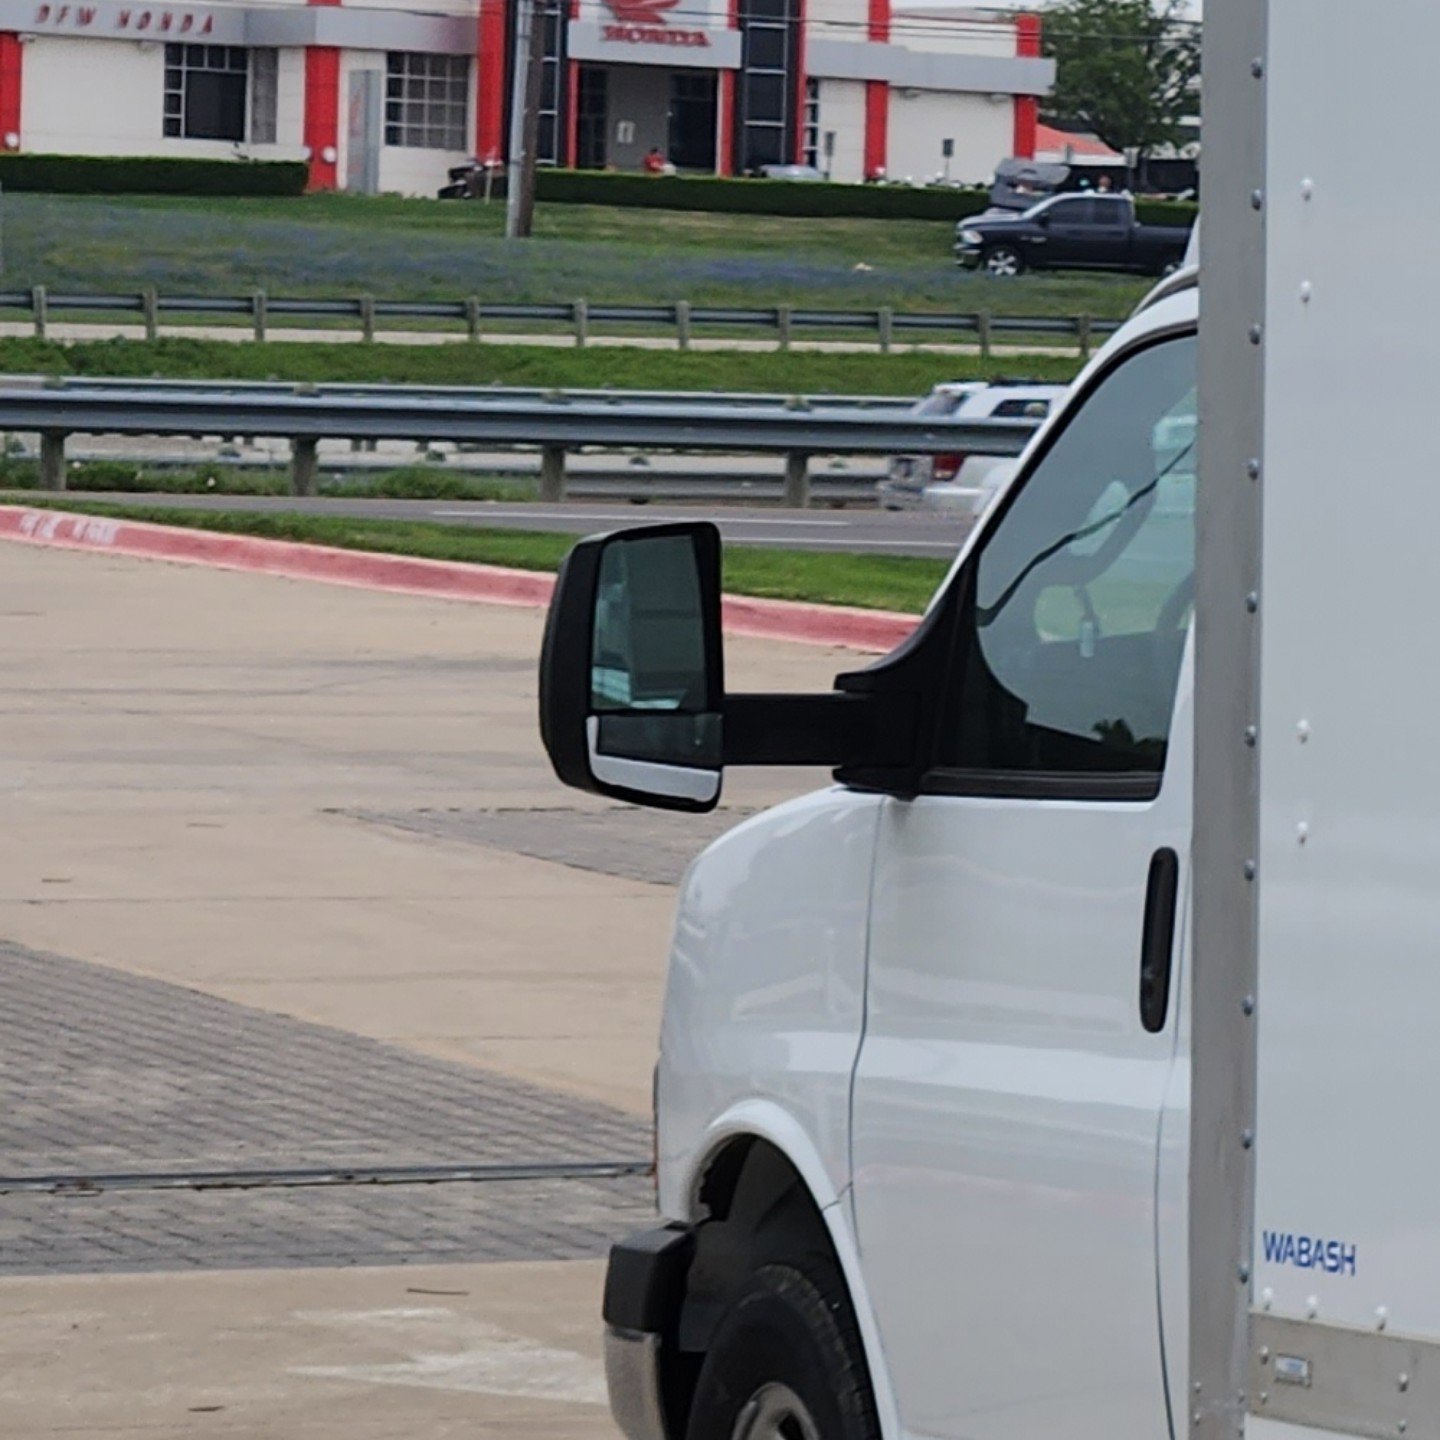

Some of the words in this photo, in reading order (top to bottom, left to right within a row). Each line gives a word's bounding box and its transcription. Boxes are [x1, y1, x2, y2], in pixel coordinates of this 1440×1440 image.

[117, 9, 214, 35] HONDA
[602, 25, 713, 48] HONDA
[1262, 1230, 1357, 1277] WABASH
